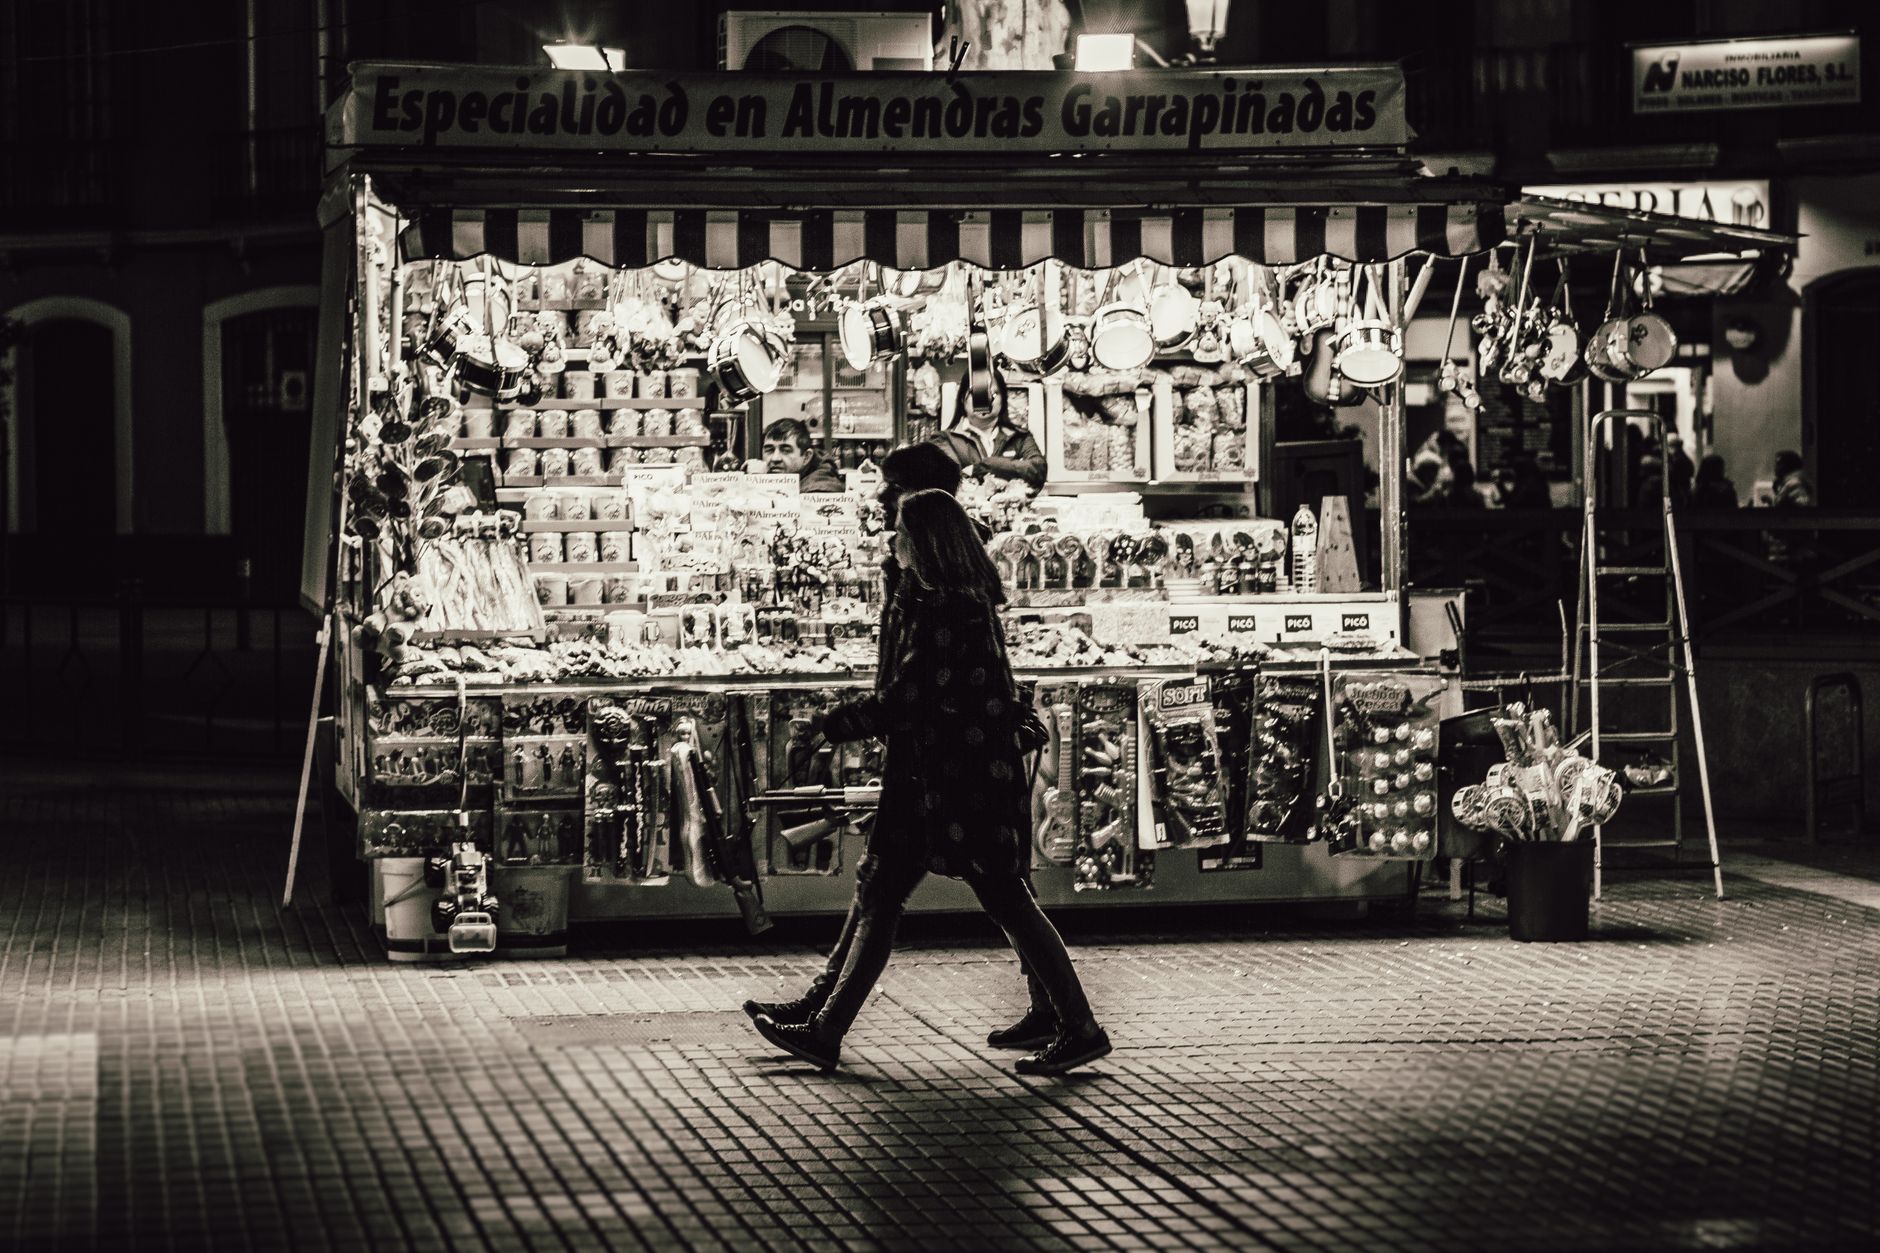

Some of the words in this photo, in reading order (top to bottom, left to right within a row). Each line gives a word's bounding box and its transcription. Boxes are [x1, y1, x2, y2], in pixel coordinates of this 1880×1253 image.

[1725, 50, 1802, 63] INMOBILIARIA
[1681, 67, 1750, 89] NARCISO
[1756, 64, 1821, 87] FLORES,
[1825, 61, 1854, 82] S.L.
[371, 74, 690, 147] Especialidad
[705, 93, 768, 139] en
[781, 80, 1046, 139] Almendras
[1061, 76, 1377, 151] Garrapiñadas
[700, 472, 739, 483] Almendro
[752, 475, 797, 485] Almendro
[810, 494, 854, 503] Almendro
[755, 509, 801, 519] Almendro
[1162, 684, 1208, 707] SOFT
[1354, 699, 1399, 711] Pesca
